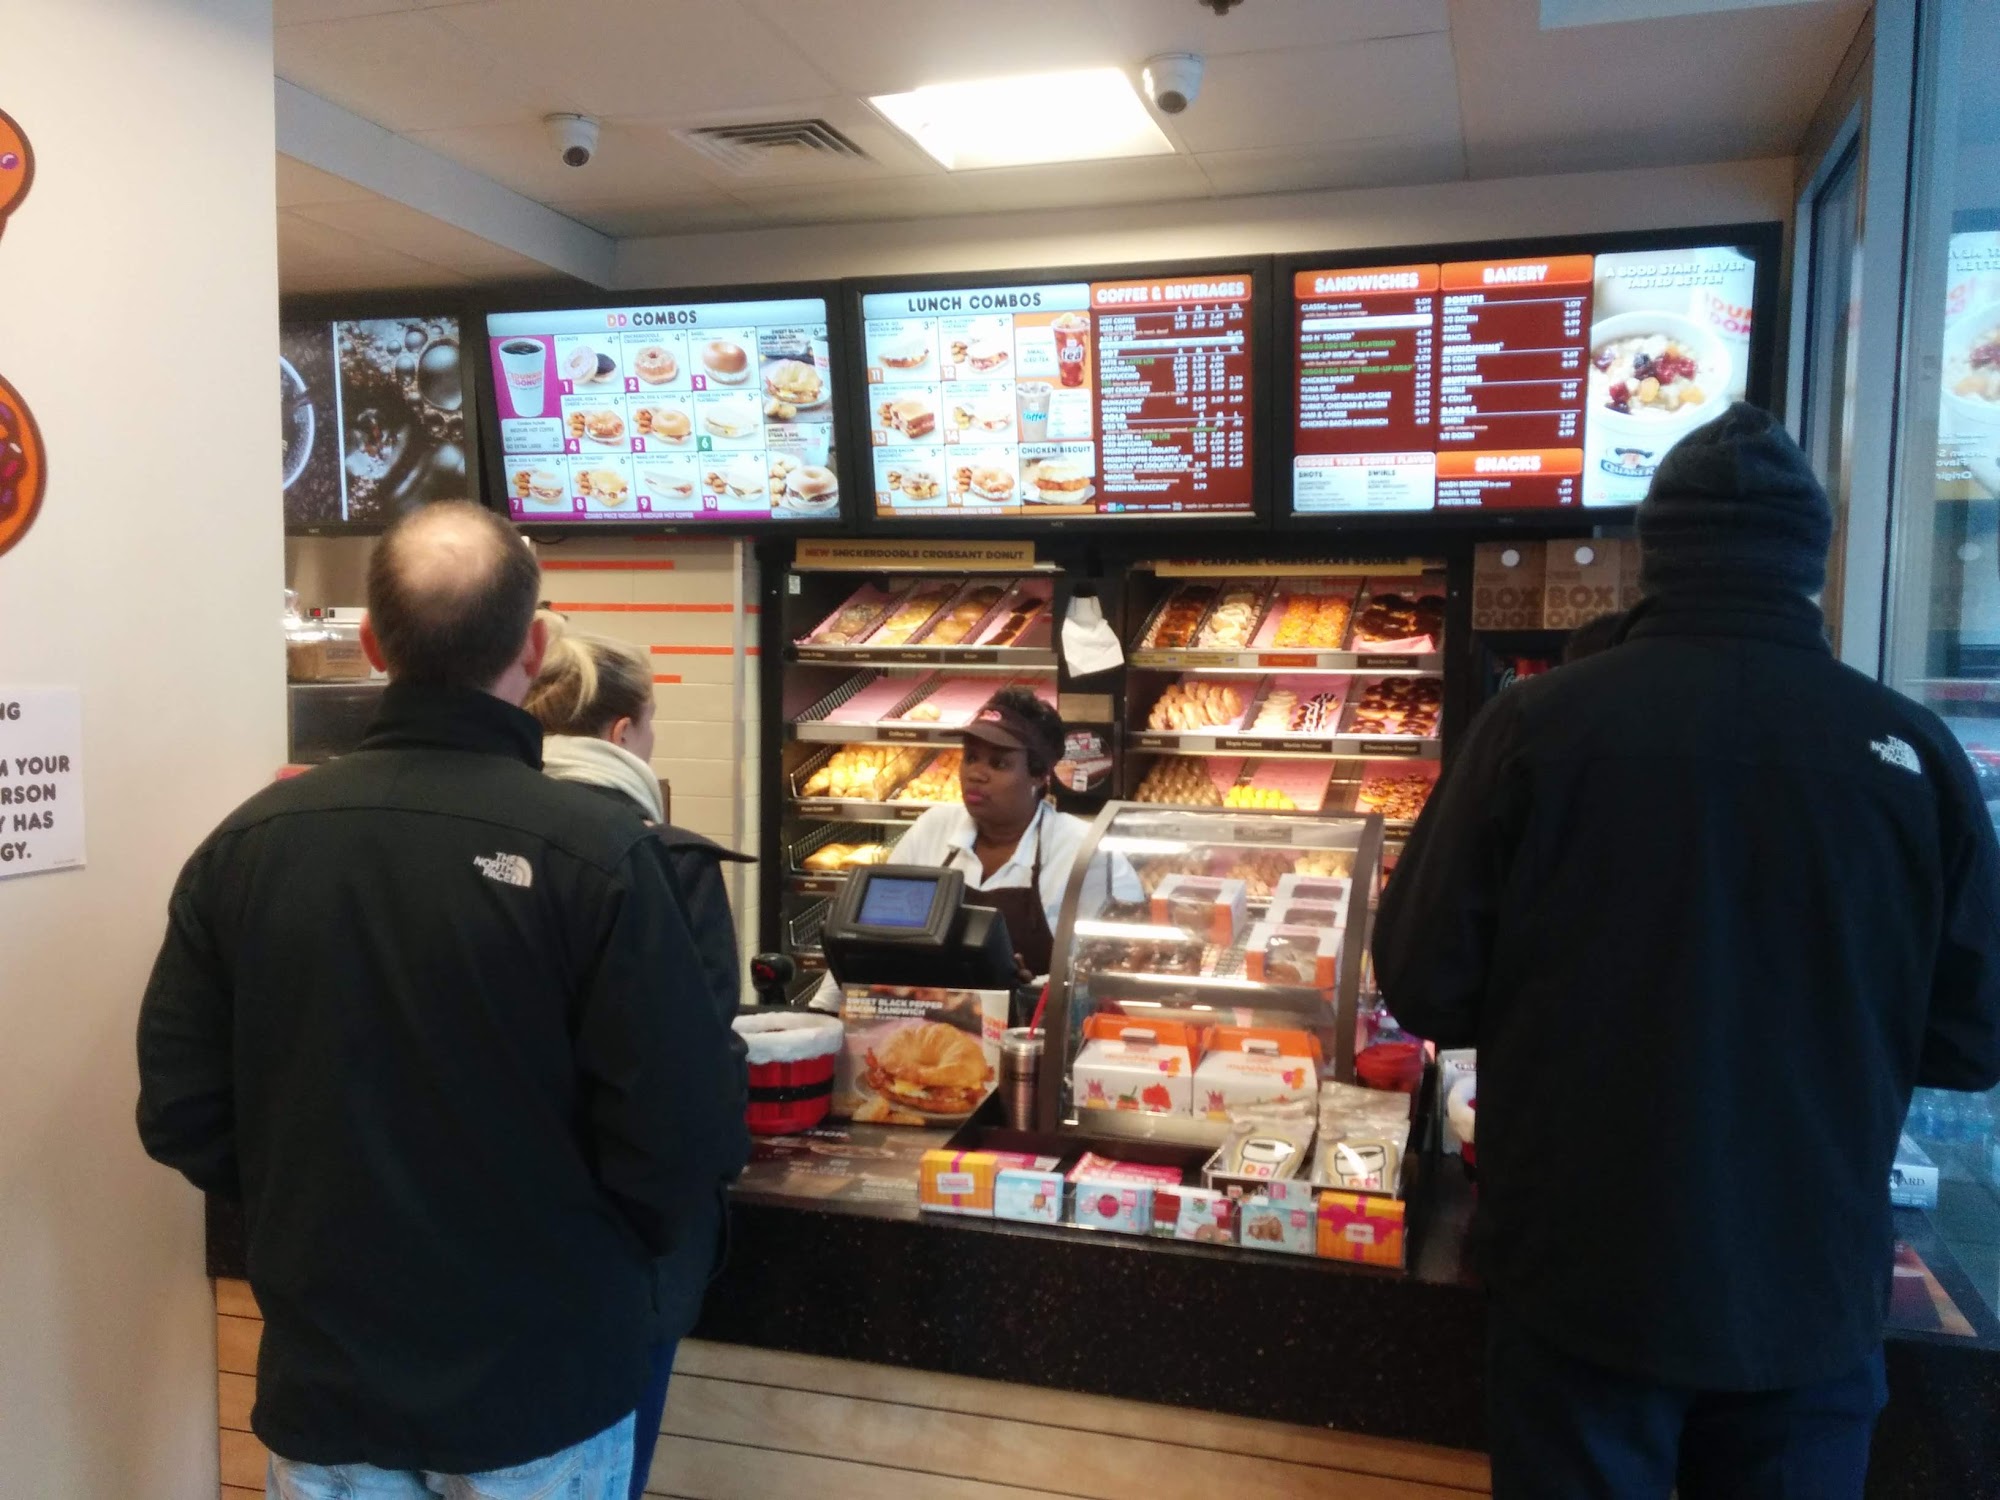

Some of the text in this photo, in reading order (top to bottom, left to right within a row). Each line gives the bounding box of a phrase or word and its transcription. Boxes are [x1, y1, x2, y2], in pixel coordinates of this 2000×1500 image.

[1483, 264, 1548, 284] BAKERY
[1618, 266, 1658, 278] GOOD
[1660, 264, 1700, 275] START
[1704, 262, 1746, 274] NEVER
[1314, 272, 1419, 294] SANDWICHES
[1628, 276, 1724, 289] TASTED BETTER
[1097, 282, 1245, 303] COFFEE & BEVERAGES
[1444, 295, 1484, 304] DONUTS
[908, 292, 1042, 313] LUNCH COMBOS
[1301, 303, 1327, 312] CLASSIC
[607, 310, 697, 328] DD COMBOS
[1114, 316, 1136, 324] COFFEE
[1443, 325, 1467, 333] DOZEN
[1062, 346, 1082, 362] tea
[563, 376, 703, 392] 1 2 3
[1449, 394, 1473, 402] COUNT
[1441, 406, 1478, 414] BAGELS
[570, 438, 708, 452] 4 5 6
[1021, 445, 1091, 455] CHICKEN BISCUIT
[1474, 456, 1542, 473] SNACKS
[1602, 461, 1654, 476] QUAKER
[1458, 480, 1489, 488] BROWNS
[514, 498, 716, 510] 7 8 9 10
[806, 549, 1024, 560] NEW SNICKERDOODLE CROISSANT DONUT
[1476, 585, 1614, 610] BOX BOX
[15, 755, 70, 776] YOUR
[13, 810, 54, 832] HAS
[878, 998, 908, 1007] BLACK
[908, 1000, 943, 1009] PEPPER
[878, 1007, 926, 1016] SANDWICH
